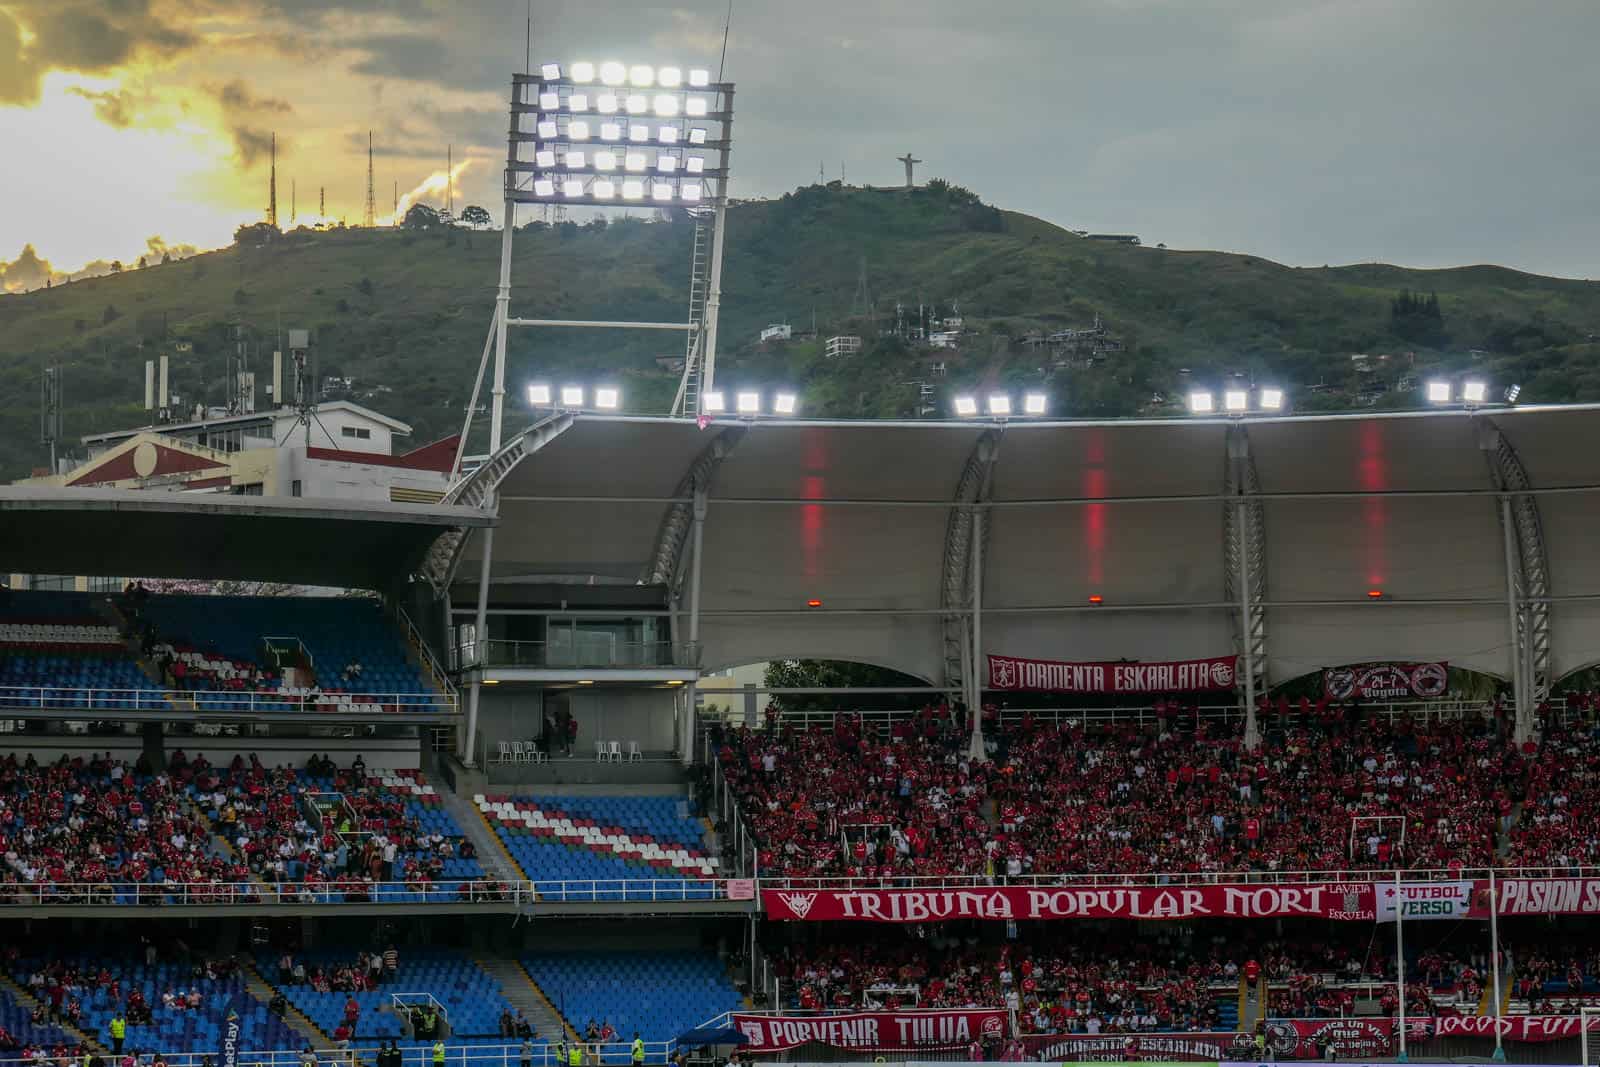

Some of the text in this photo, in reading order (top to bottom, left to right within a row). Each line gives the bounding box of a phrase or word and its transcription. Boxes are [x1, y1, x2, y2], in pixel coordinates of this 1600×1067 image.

[1017, 661, 1209, 691] TORMENTA ESKARLATA
[833, 890, 1014, 921] TRIBUNA
[1026, 889, 1212, 919] POPULAR
[1499, 880, 1582, 913] PASION
[768, 1015, 971, 1047] PORVENIR TULUA
